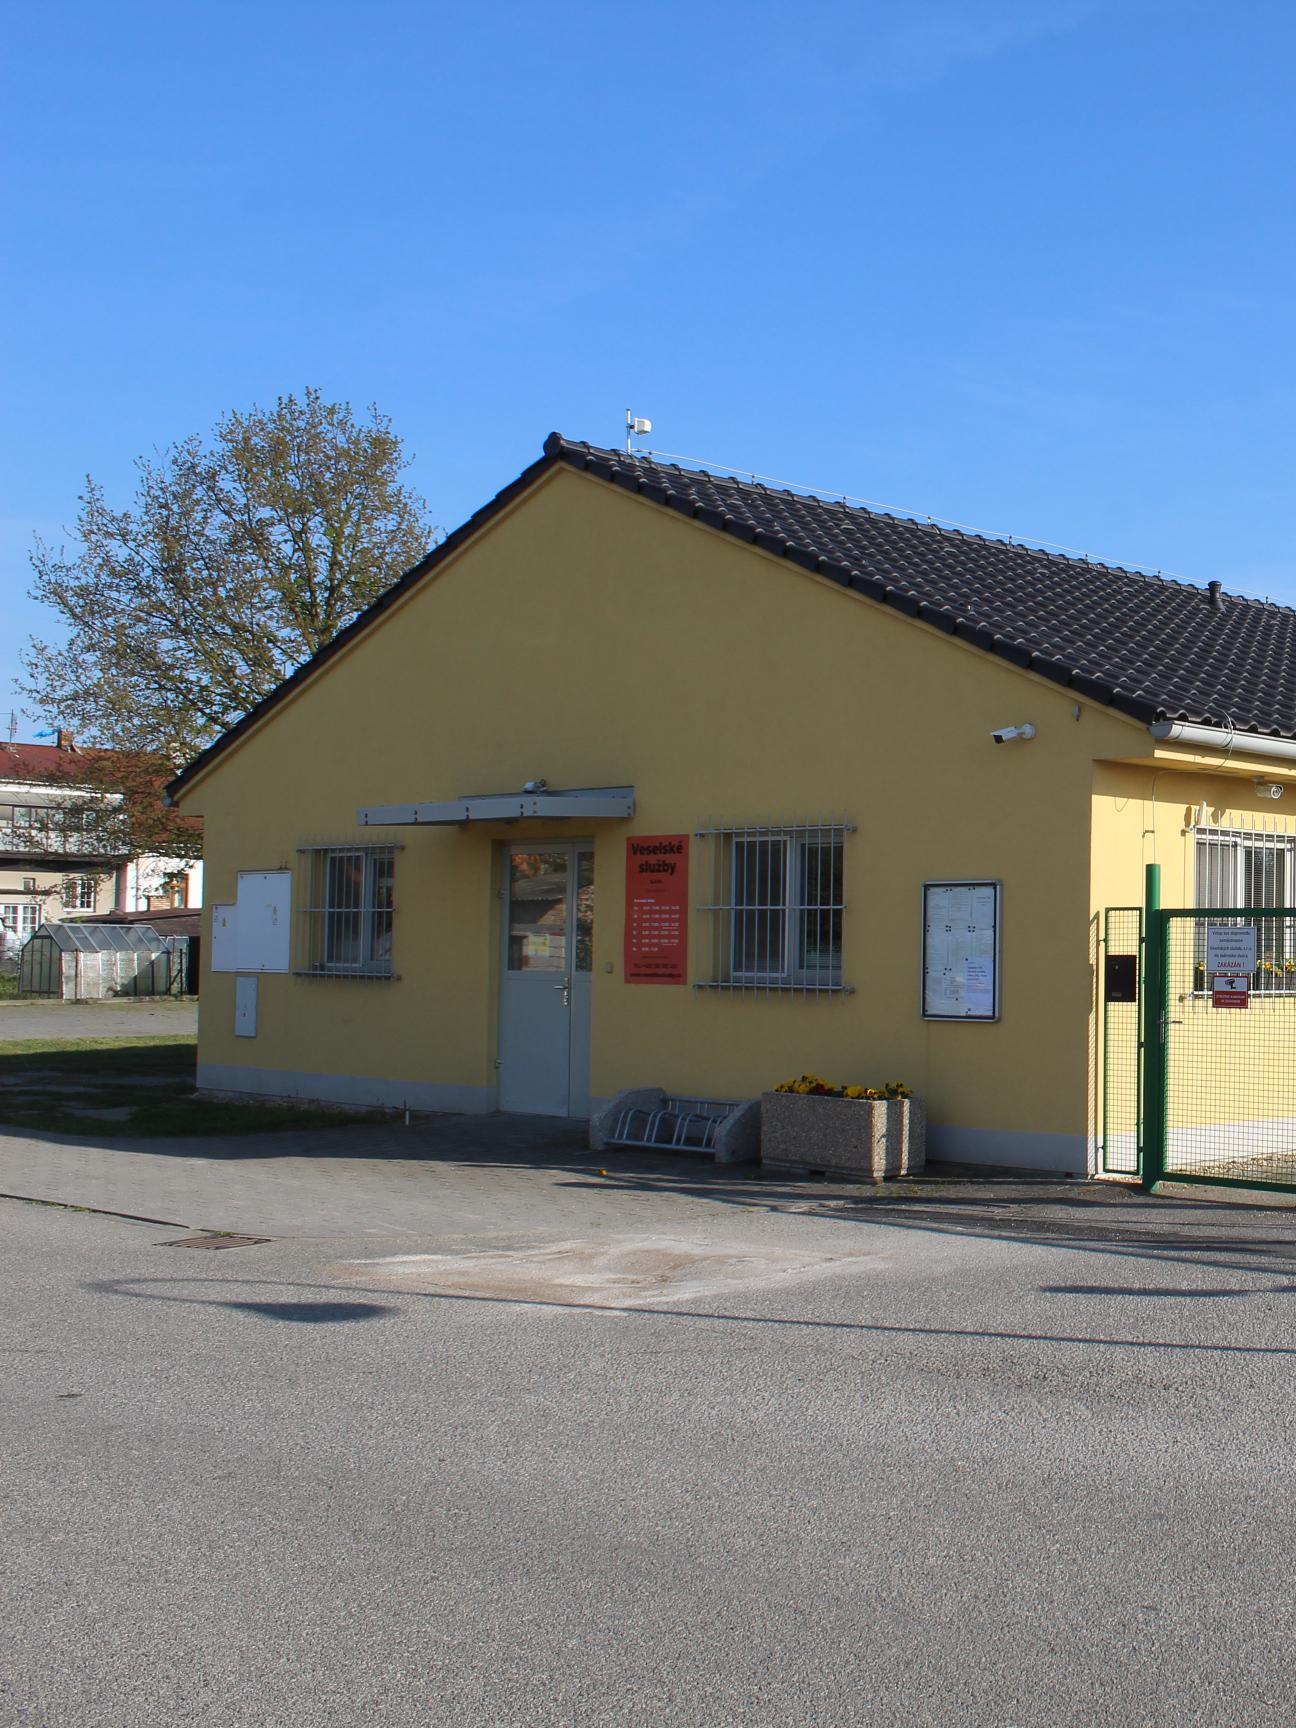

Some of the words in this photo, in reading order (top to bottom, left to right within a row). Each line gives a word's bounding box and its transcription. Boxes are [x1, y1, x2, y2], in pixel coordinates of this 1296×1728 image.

[631, 841, 684, 856] Veselské
[639, 859, 677, 876] služby
[1217, 960, 1241, 968] ZAKÁZÁN
